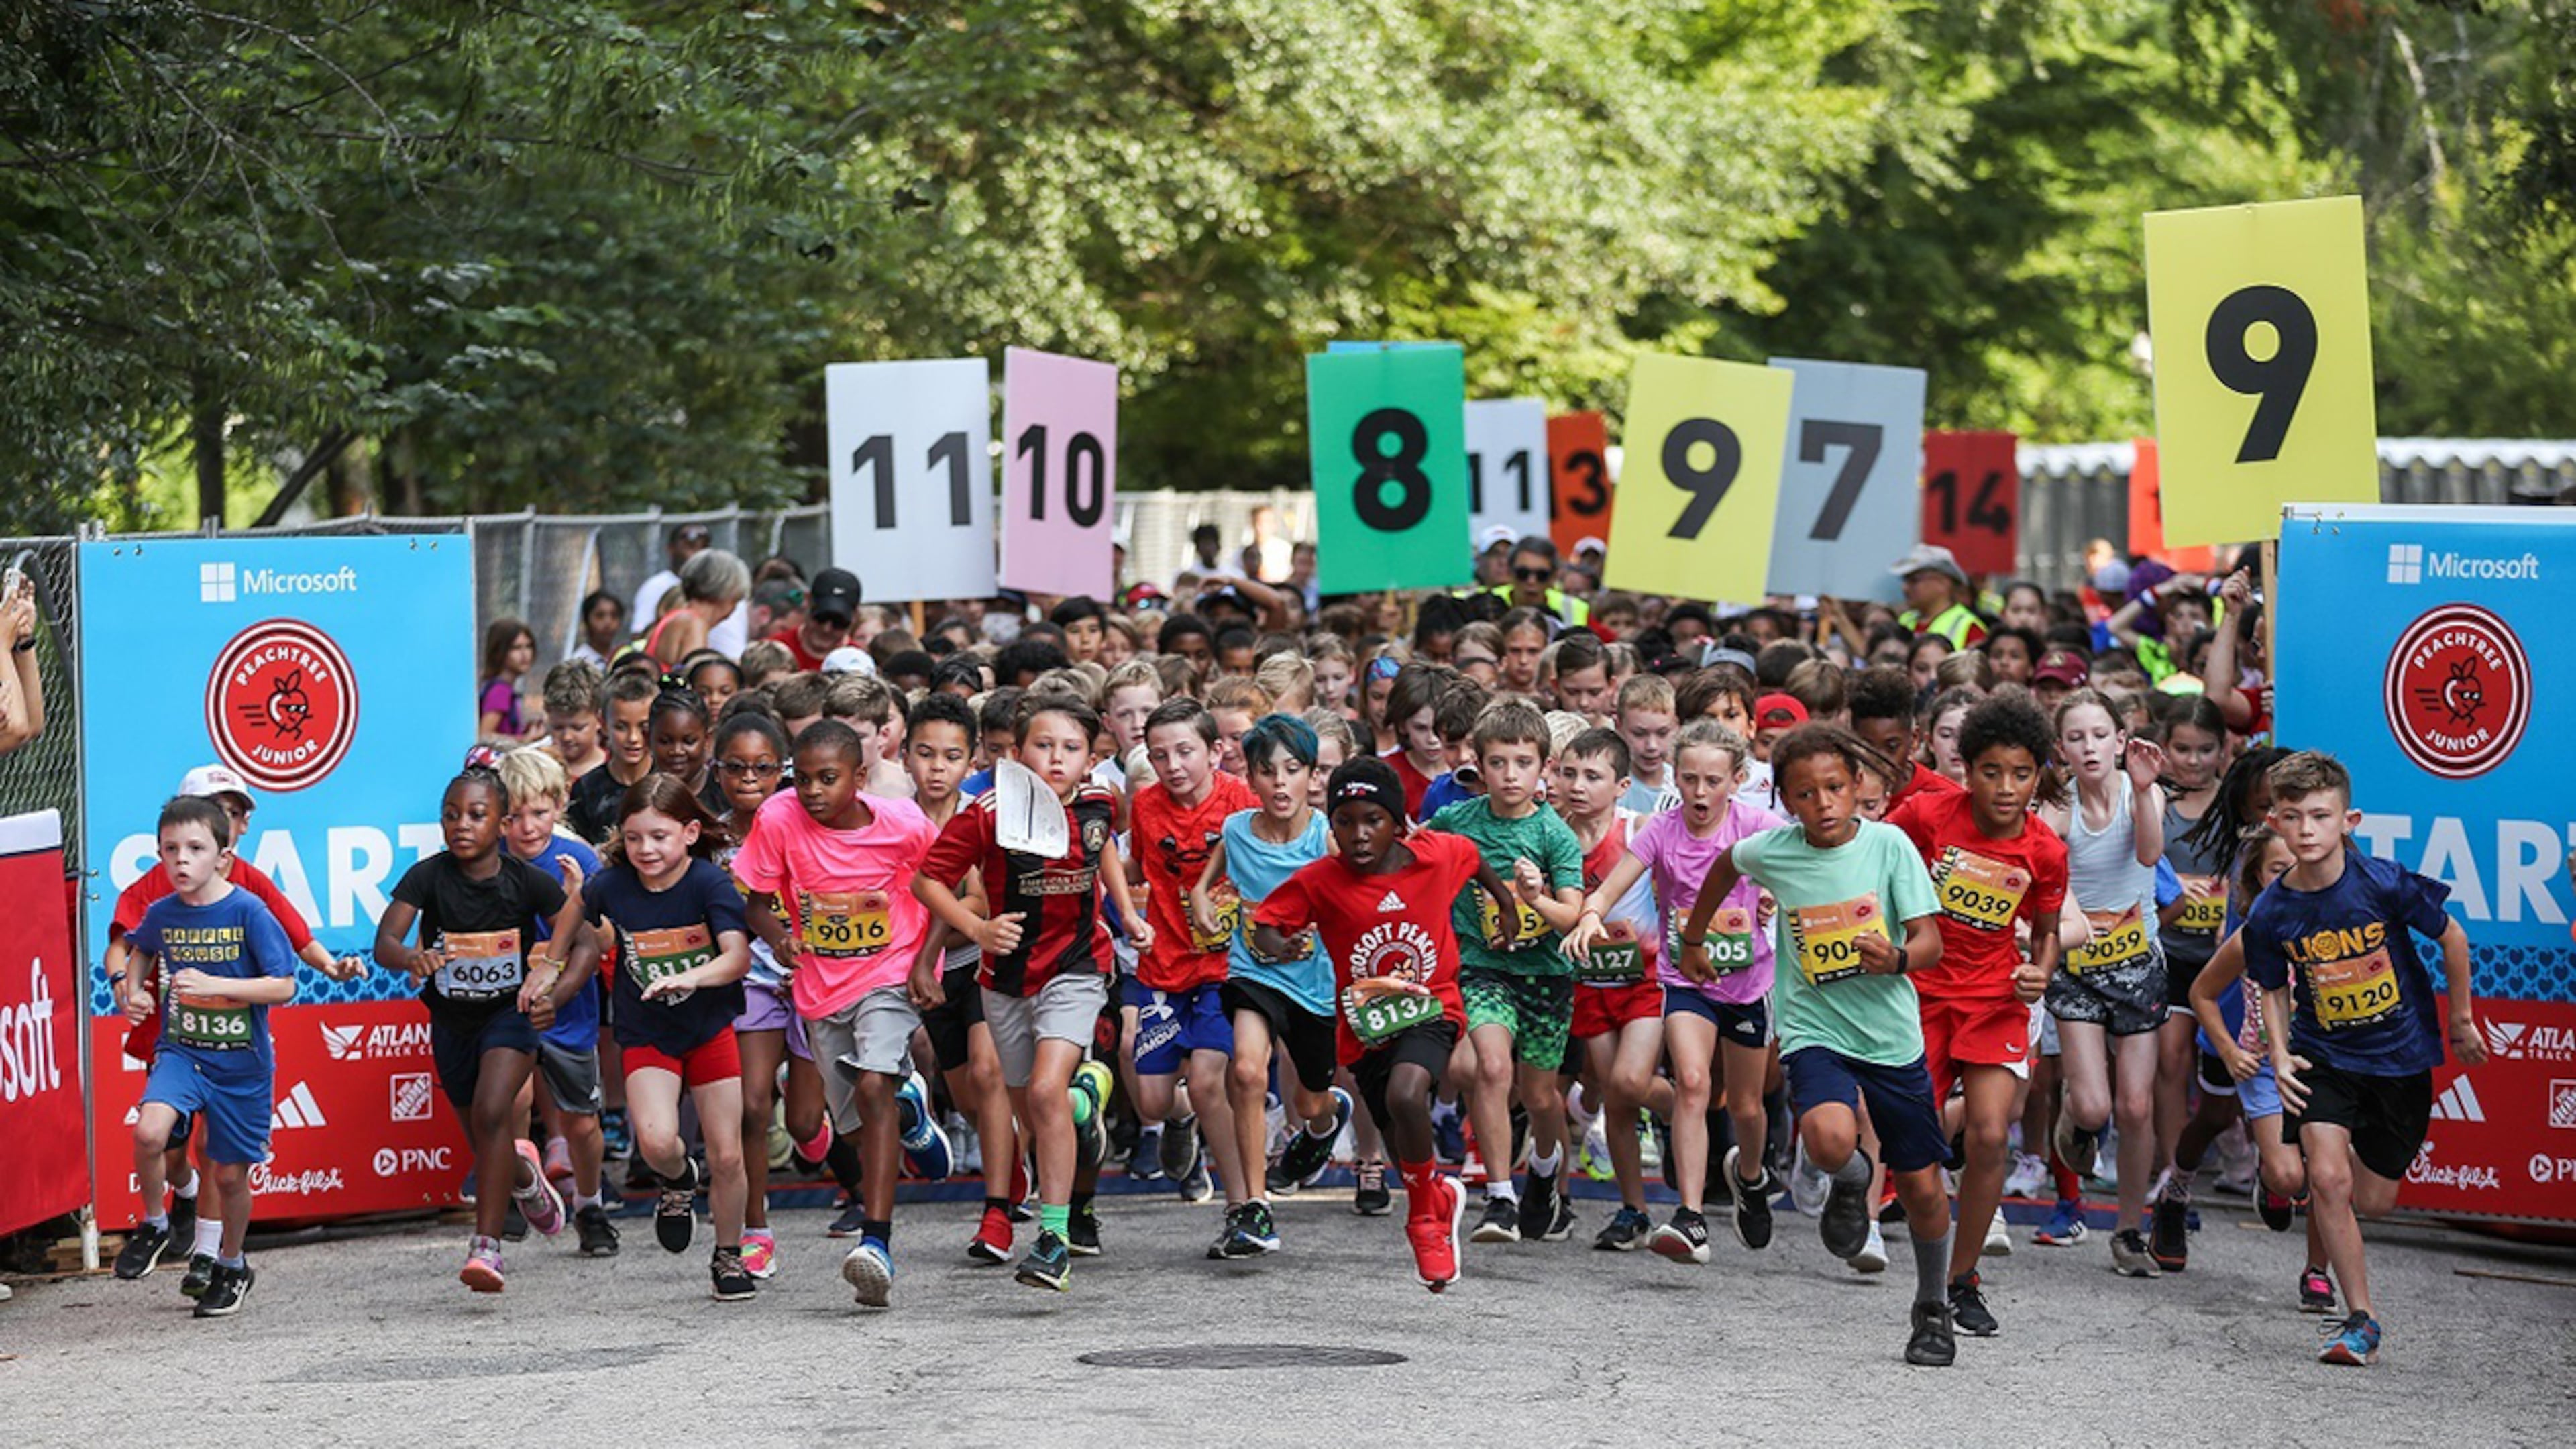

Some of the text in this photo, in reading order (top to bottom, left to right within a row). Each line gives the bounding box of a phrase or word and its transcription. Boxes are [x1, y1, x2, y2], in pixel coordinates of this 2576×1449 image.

[2205, 284, 2318, 463] 9
[852, 431, 972, 530] 11
[1017, 424, 1106, 529] 10
[1351, 407, 1432, 533] 8
[1468, 450, 1532, 515] 11
[1660, 417, 1742, 541] 9
[1799, 419, 1884, 541] 7
[1929, 470, 2010, 536] 14
[243, 565, 358, 594] Microsoft
[2428, 551, 2540, 580] Microsoft
[235, 646, 328, 686] PEACHTREE
[2413, 632, 2503, 671] PEACHTREE
[251, 739, 319, 765] JUNIOR
[2424, 727, 2490, 751] JUNIOR
[2354, 813, 2576, 924] TAR
[1948, 884, 2011, 917] 9039
[2184, 905, 2225, 922] 085
[818, 919, 884, 943] 9016
[2085, 929, 2141, 959] 9059
[1813, 940, 1861, 964] 90
[453, 962, 516, 983] 6063
[2328, 981, 2394, 1012] 9120
[0, 956, 61, 1103] soft
[182, 1012, 247, 1035] 8136
[1366, 996, 1431, 1032] 8137
[366, 1022, 433, 1048] ATLAN
[2527, 1026, 2576, 1051] ATLA
[2527, 1049, 2573, 1061] TRACK
[402, 1147, 451, 1171] PNC
